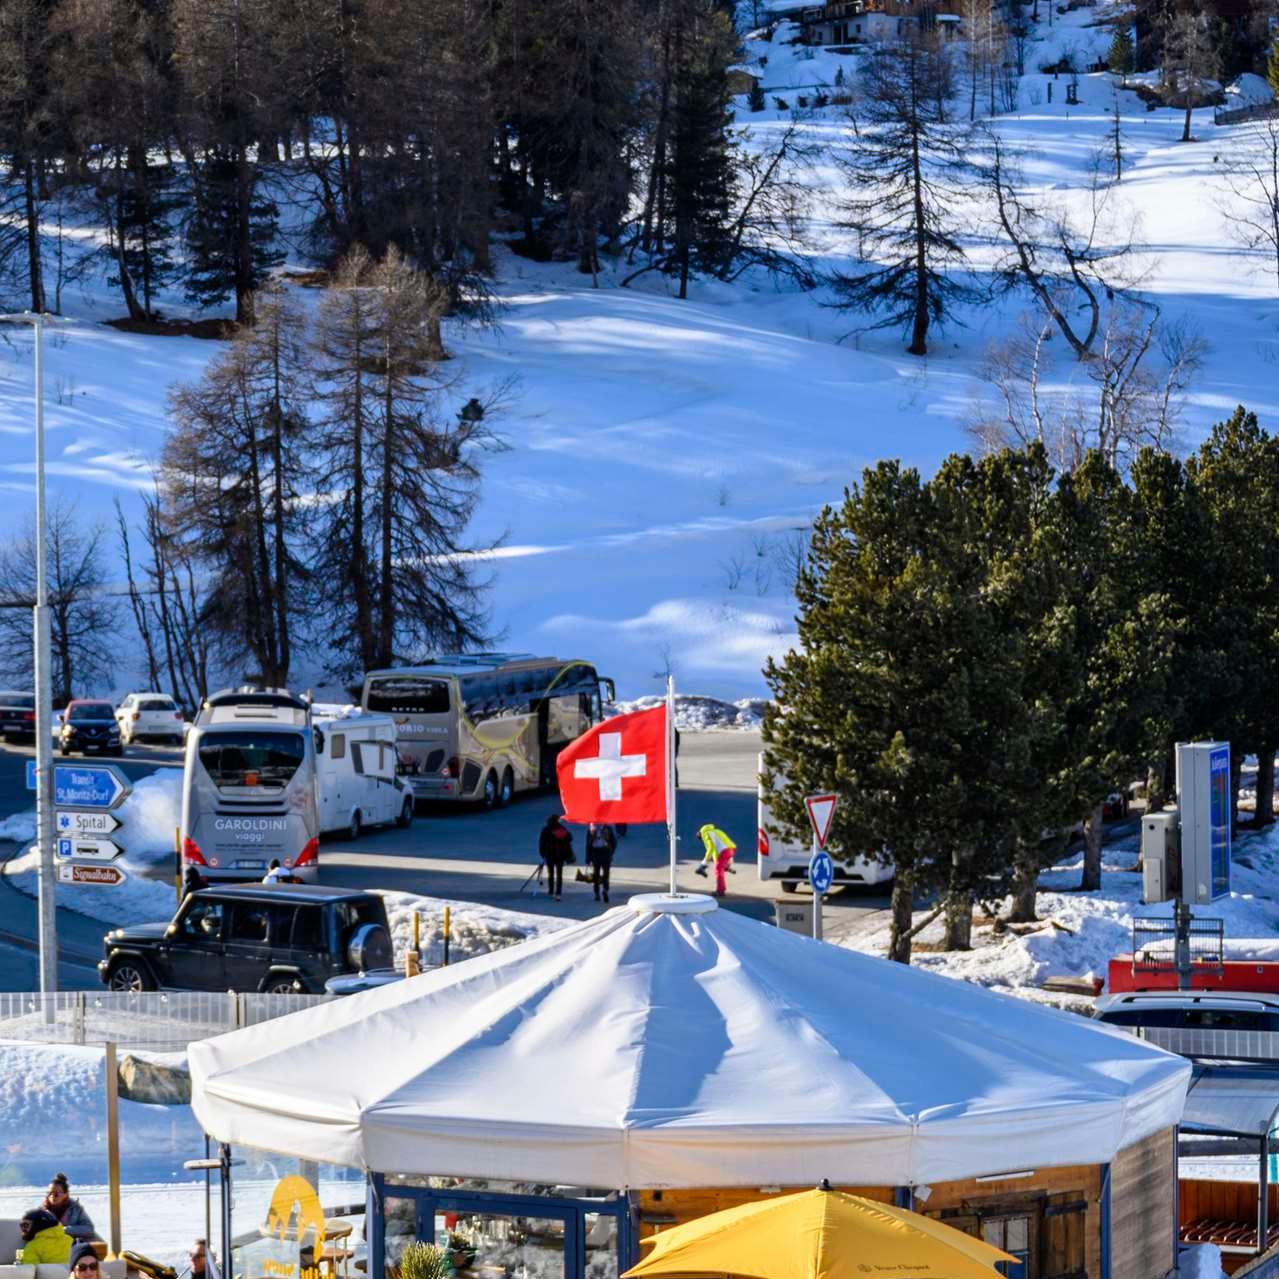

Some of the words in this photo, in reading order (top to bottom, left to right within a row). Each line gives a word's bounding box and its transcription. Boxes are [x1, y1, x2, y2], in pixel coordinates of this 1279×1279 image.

[76, 814, 106, 830] Spital
[214, 819, 287, 830] GAROLDINI
[234, 831, 265, 841] viaggi
